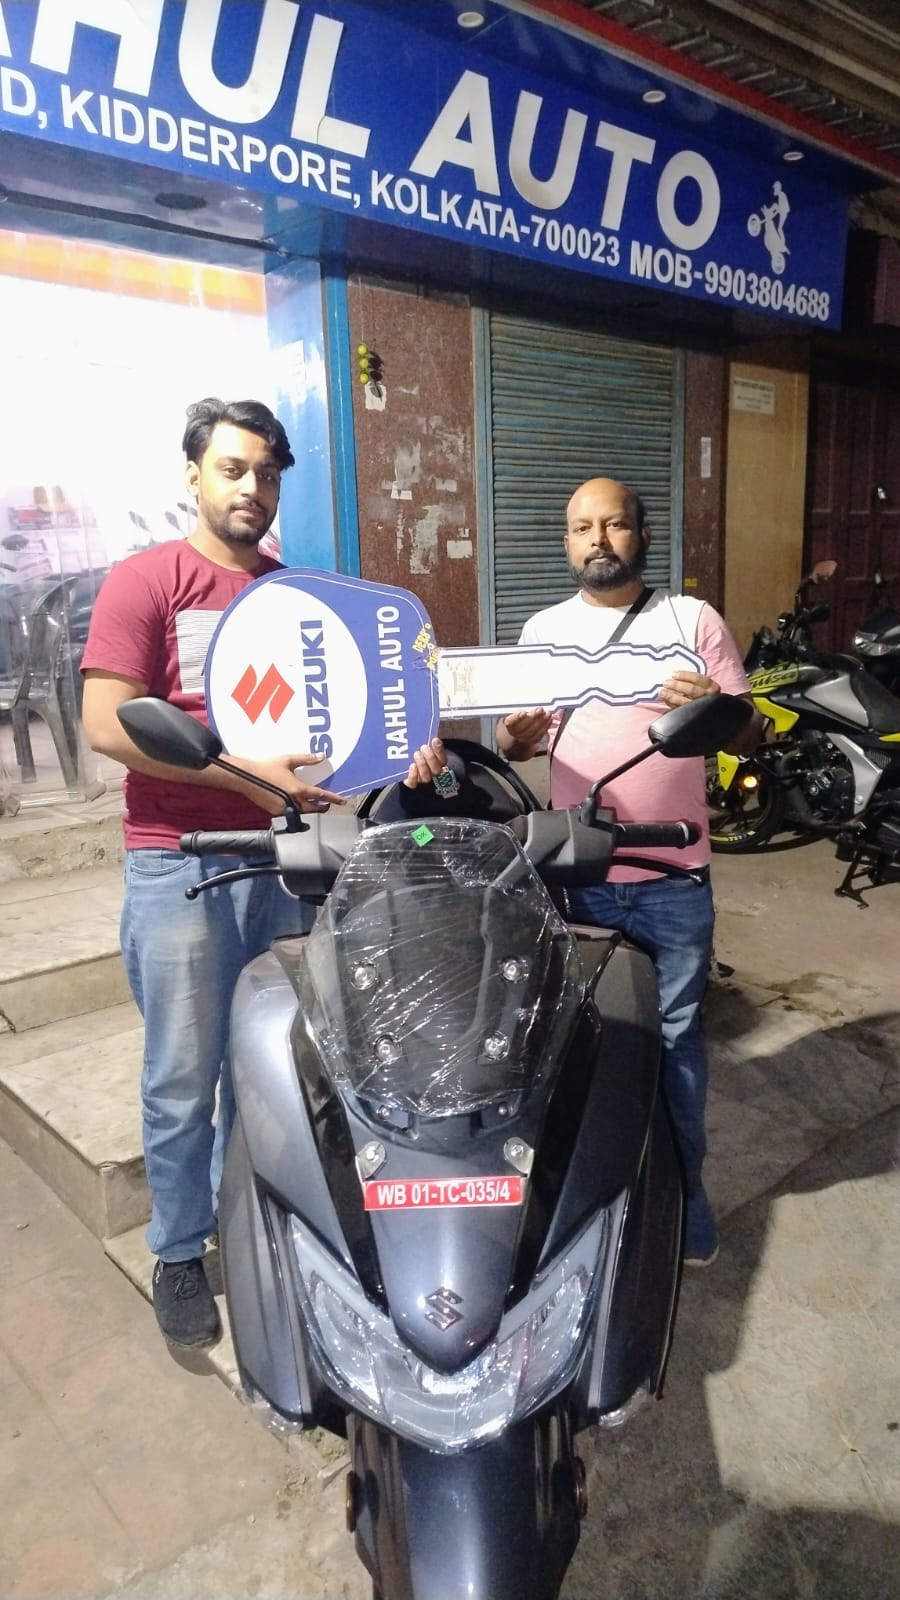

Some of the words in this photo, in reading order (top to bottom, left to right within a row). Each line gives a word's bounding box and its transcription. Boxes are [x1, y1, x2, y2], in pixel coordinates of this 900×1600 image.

[0, 0, 370, 172] HUL
[409, 70, 720, 251] AUTO
[60, 84, 360, 208] KIDDERPORE,
[371, 170, 621, 267] KOLKATA-700023
[630, 241, 830, 322] MOB-9903804688
[300, 620, 333, 760] SUZUKI
[376, 605, 403, 672] AUTO
[382, 678, 409, 760] RAHUL
[377, 1184, 407, 1206] WB
